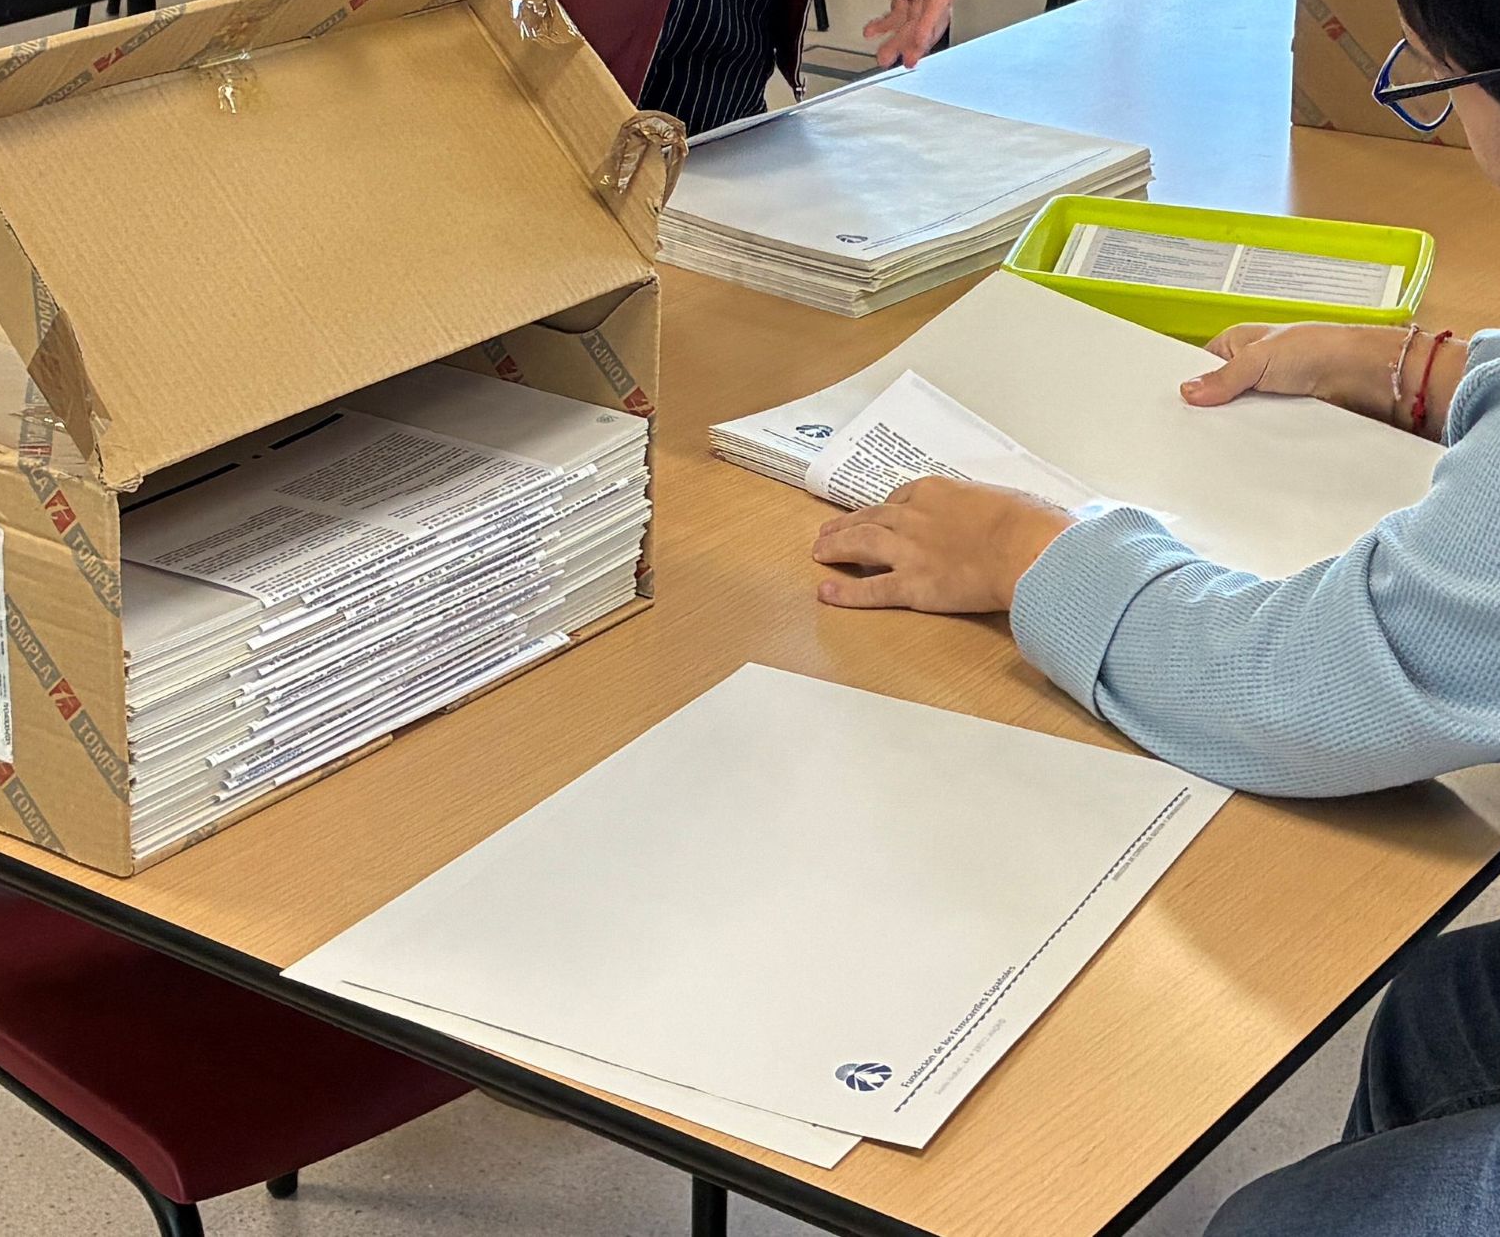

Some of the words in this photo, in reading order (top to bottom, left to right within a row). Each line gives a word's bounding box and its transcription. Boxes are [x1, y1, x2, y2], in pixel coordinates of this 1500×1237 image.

[70, 531, 122, 610] TOMPLA
[76, 719, 131, 795] TOMPLA
[901, 1054, 937, 1088] Fundación
